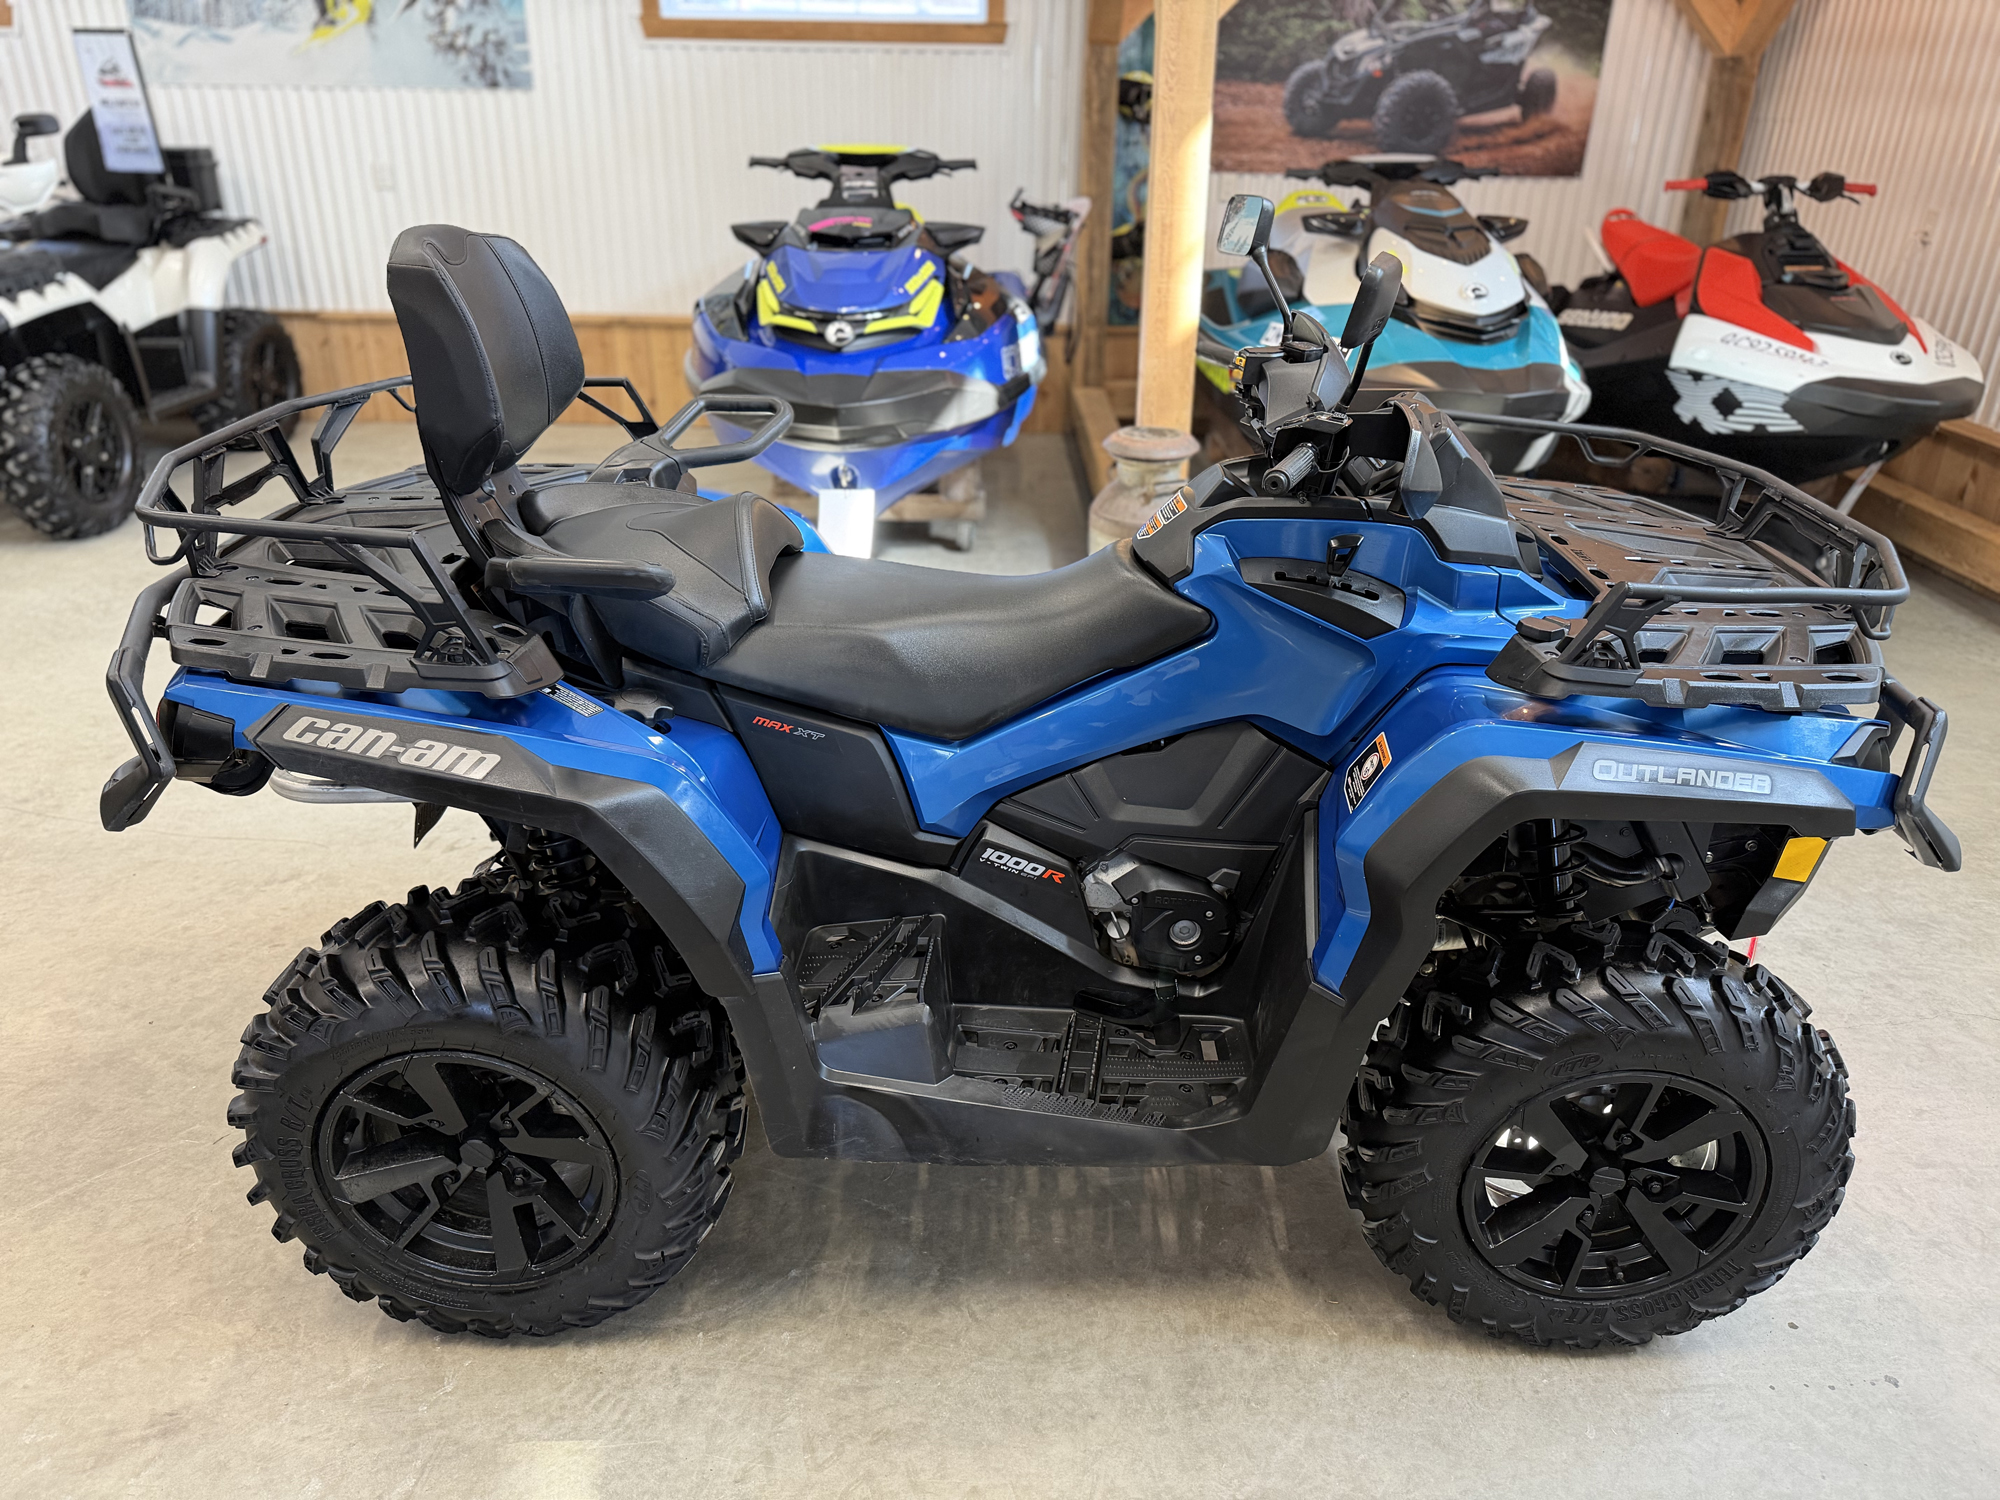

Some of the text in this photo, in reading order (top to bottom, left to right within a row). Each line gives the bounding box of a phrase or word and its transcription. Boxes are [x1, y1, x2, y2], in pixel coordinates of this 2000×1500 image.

[752, 716, 826, 741] MAX XT
[282, 716, 501, 780] can-am
[1593, 759, 1772, 795] OUTLANDER
[979, 857, 1020, 875] V-TWIN
[981, 847, 1066, 884] 1000R
[1553, 1055, 1600, 1077] ITP
[277, 1136, 307, 1191] CROSS
[1681, 1258, 1745, 1301] TERRA
[1615, 1291, 1683, 1322] CROSS
